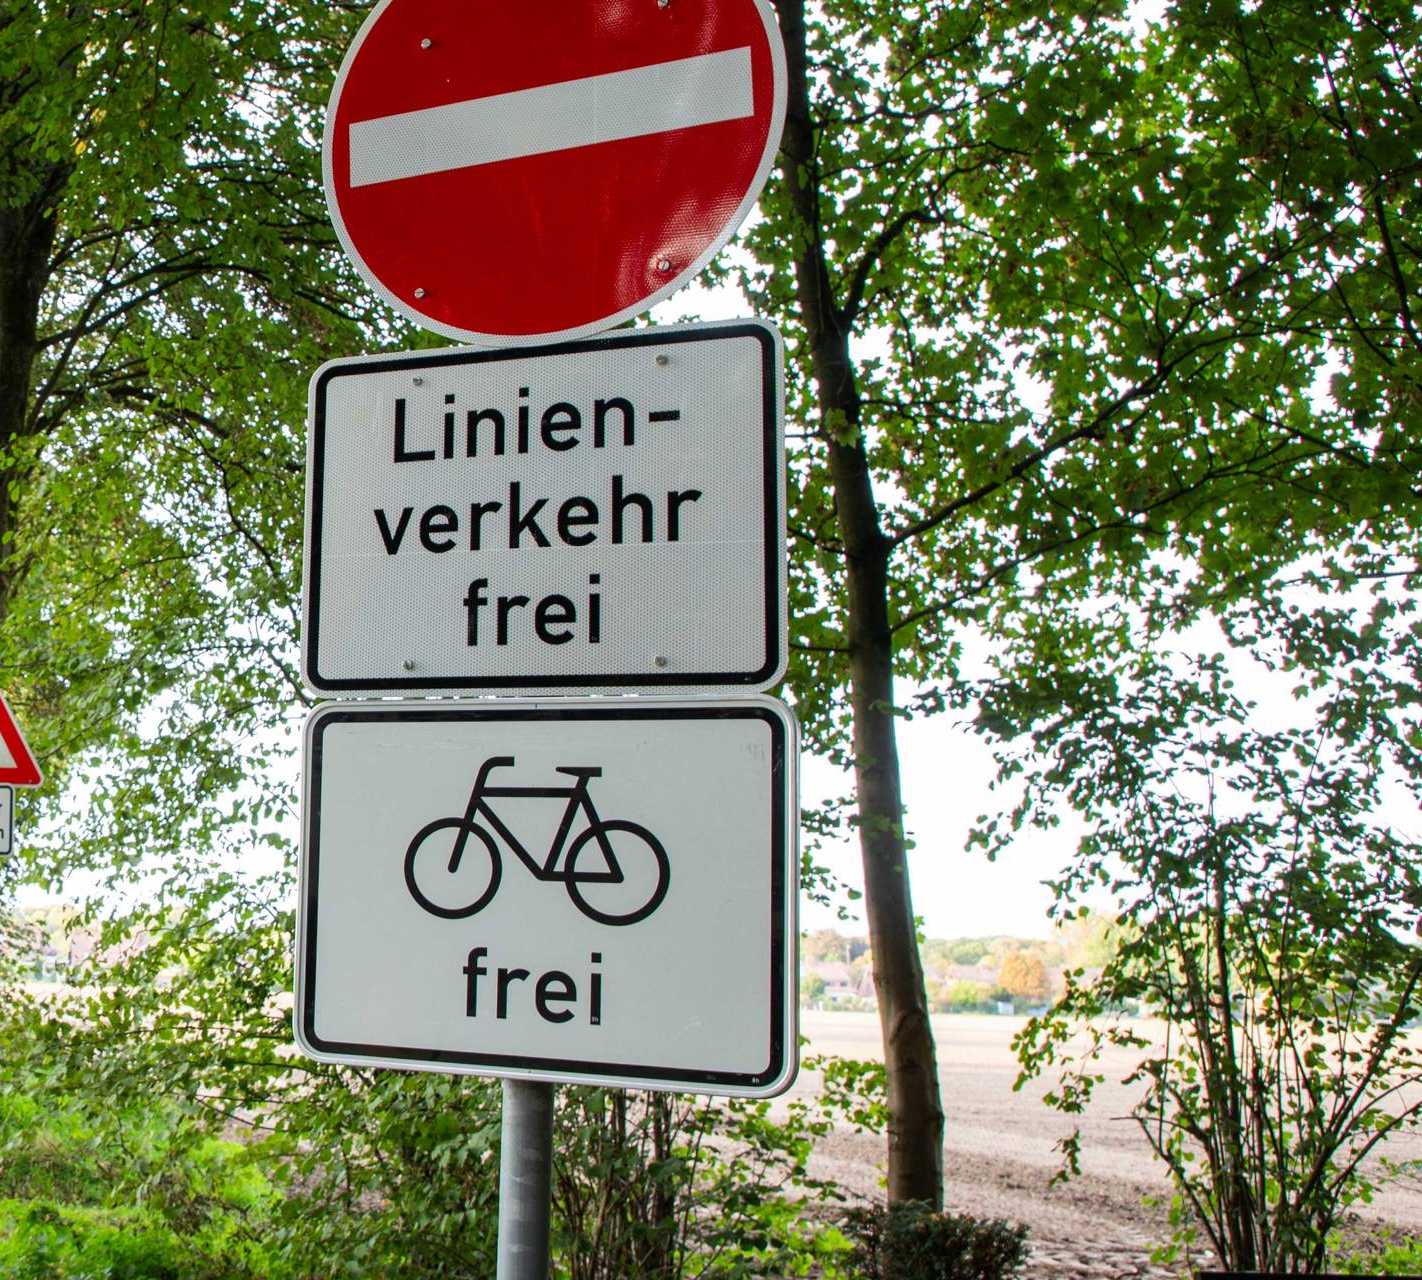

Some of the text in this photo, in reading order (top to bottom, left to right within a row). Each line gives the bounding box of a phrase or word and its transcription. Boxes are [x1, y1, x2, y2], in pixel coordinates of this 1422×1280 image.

[393, 387, 681, 464] Linien-
[374, 474, 703, 556] verkehr
[463, 573, 601, 647] frei
[463, 947, 602, 1026] frei
